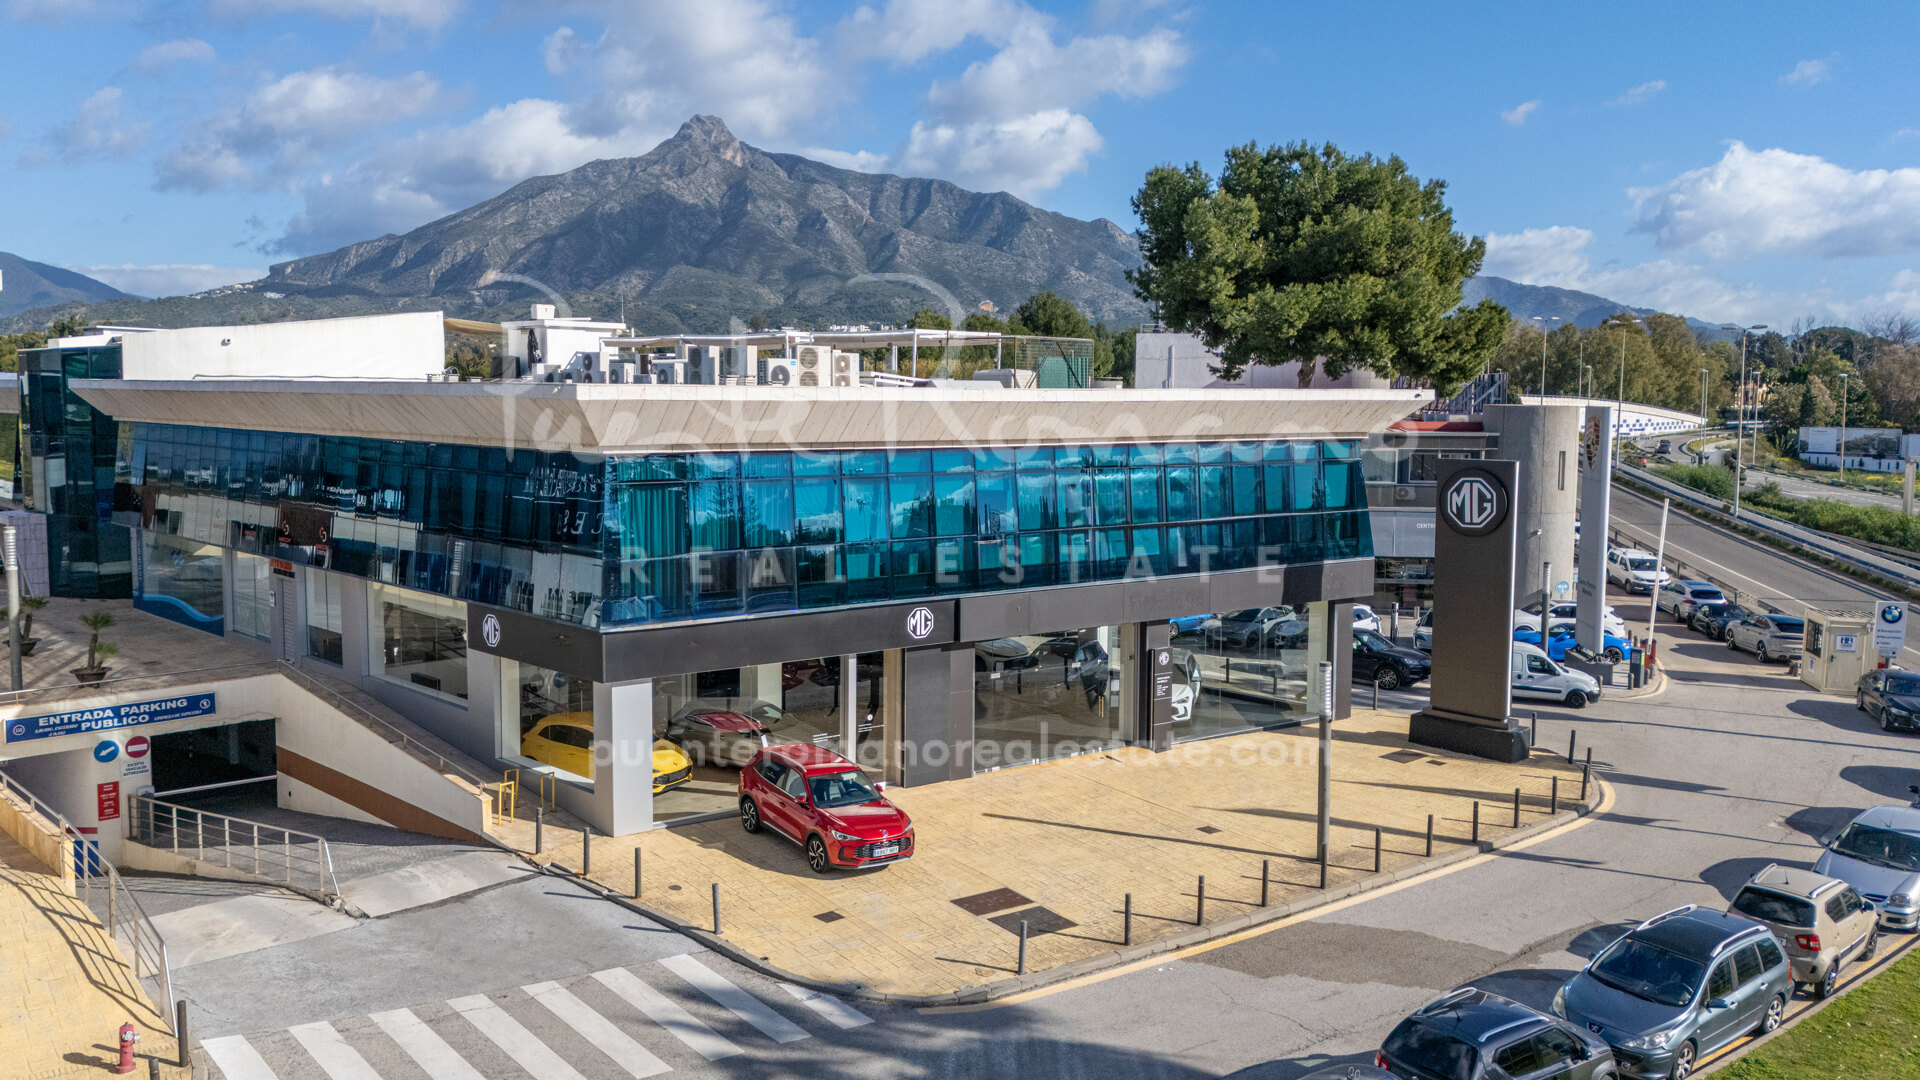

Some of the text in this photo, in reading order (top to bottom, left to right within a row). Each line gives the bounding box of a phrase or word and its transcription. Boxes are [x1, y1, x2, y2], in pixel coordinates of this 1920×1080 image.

[1451, 482, 1492, 524] MG
[483, 617, 499, 645] MG
[908, 610, 932, 636] MG
[38, 698, 188, 727] ENTRADA PARKING
[81, 714, 149, 731] PUBLICO
